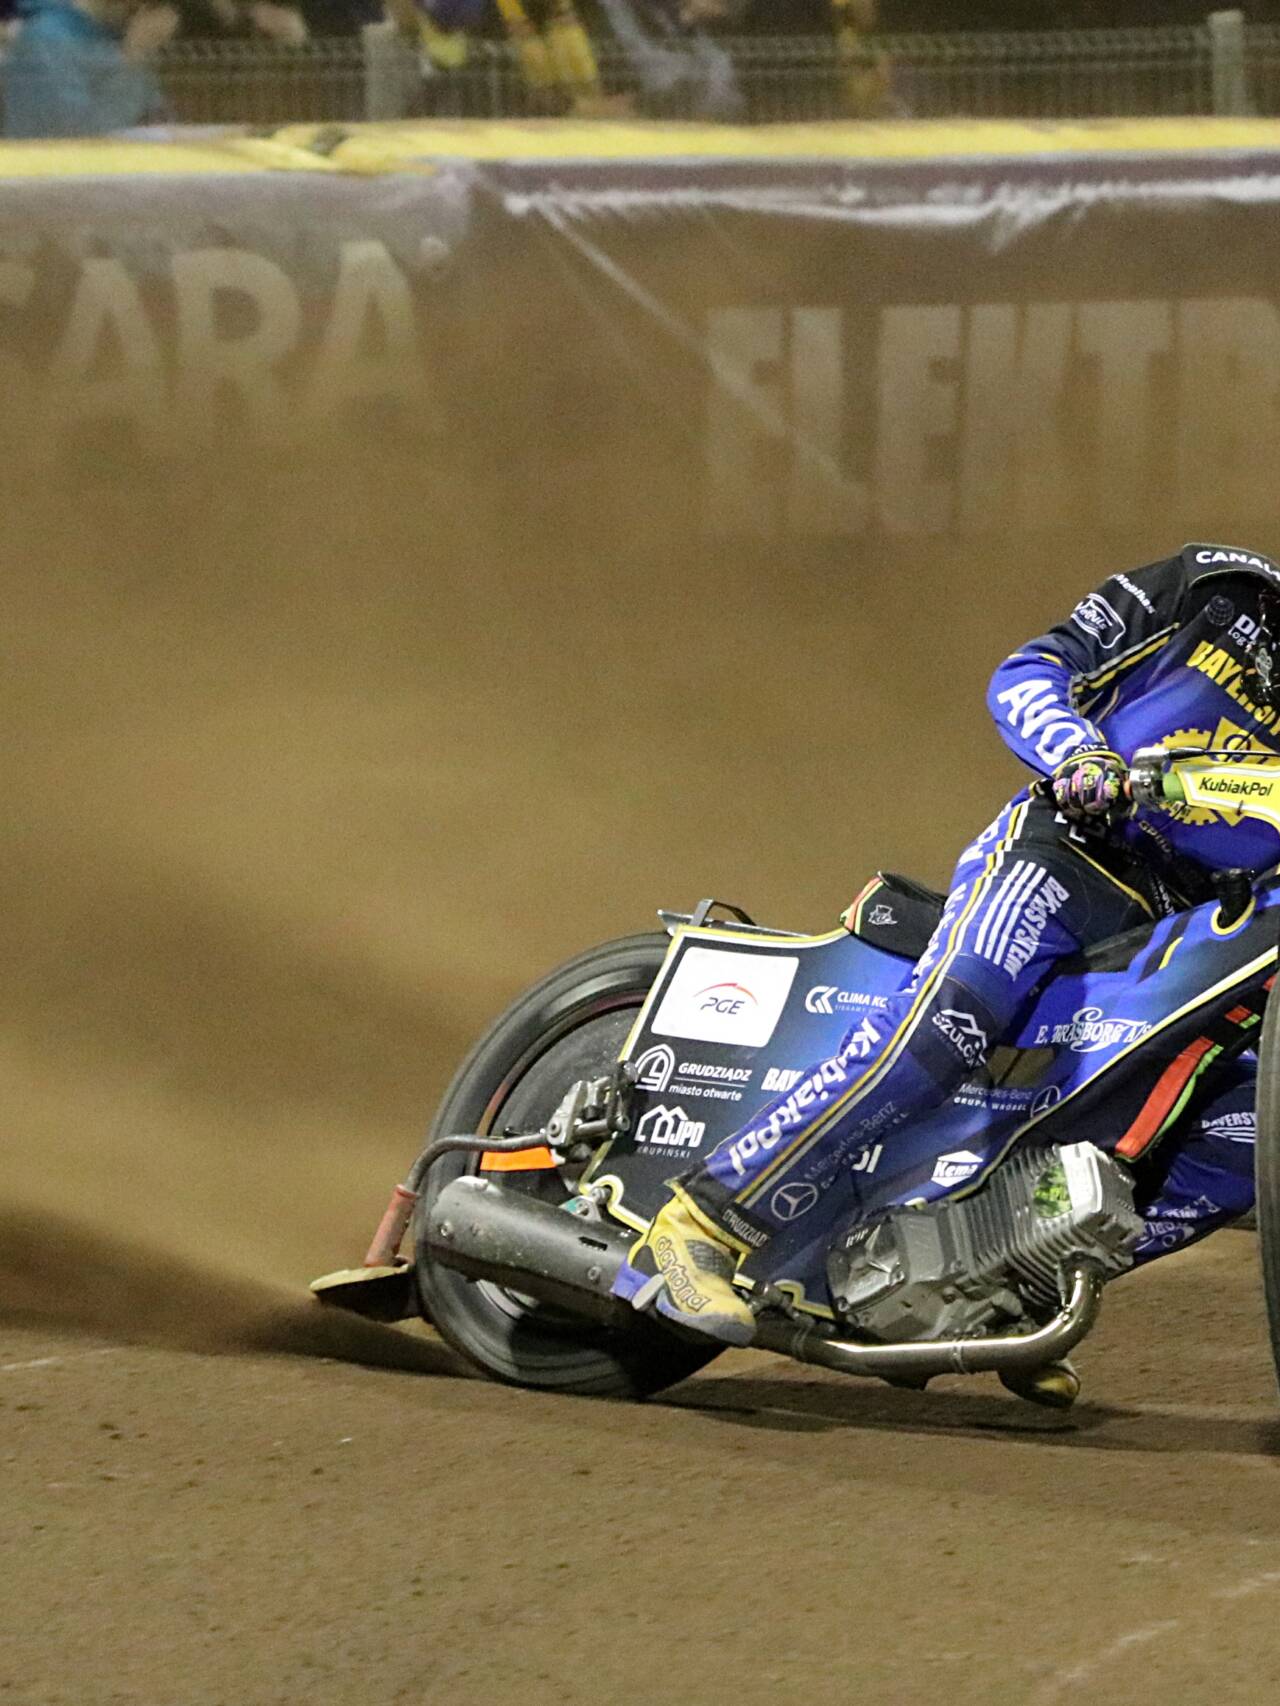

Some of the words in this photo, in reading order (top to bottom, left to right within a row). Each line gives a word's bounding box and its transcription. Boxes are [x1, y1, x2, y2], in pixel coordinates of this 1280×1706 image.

[0, 238, 445, 455] ARA
[1199, 776, 1274, 797] KubiakPol
[700, 997, 745, 1015] PGE
[837, 991, 870, 1005] CLIMA
[871, 995, 888, 1008] KC
[678, 1062, 753, 1082] GRUDZIĄDZ
[668, 1084, 702, 1097] miasto
[703, 1086, 743, 1101] otwarte
[655, 1235, 712, 1313] daytona
